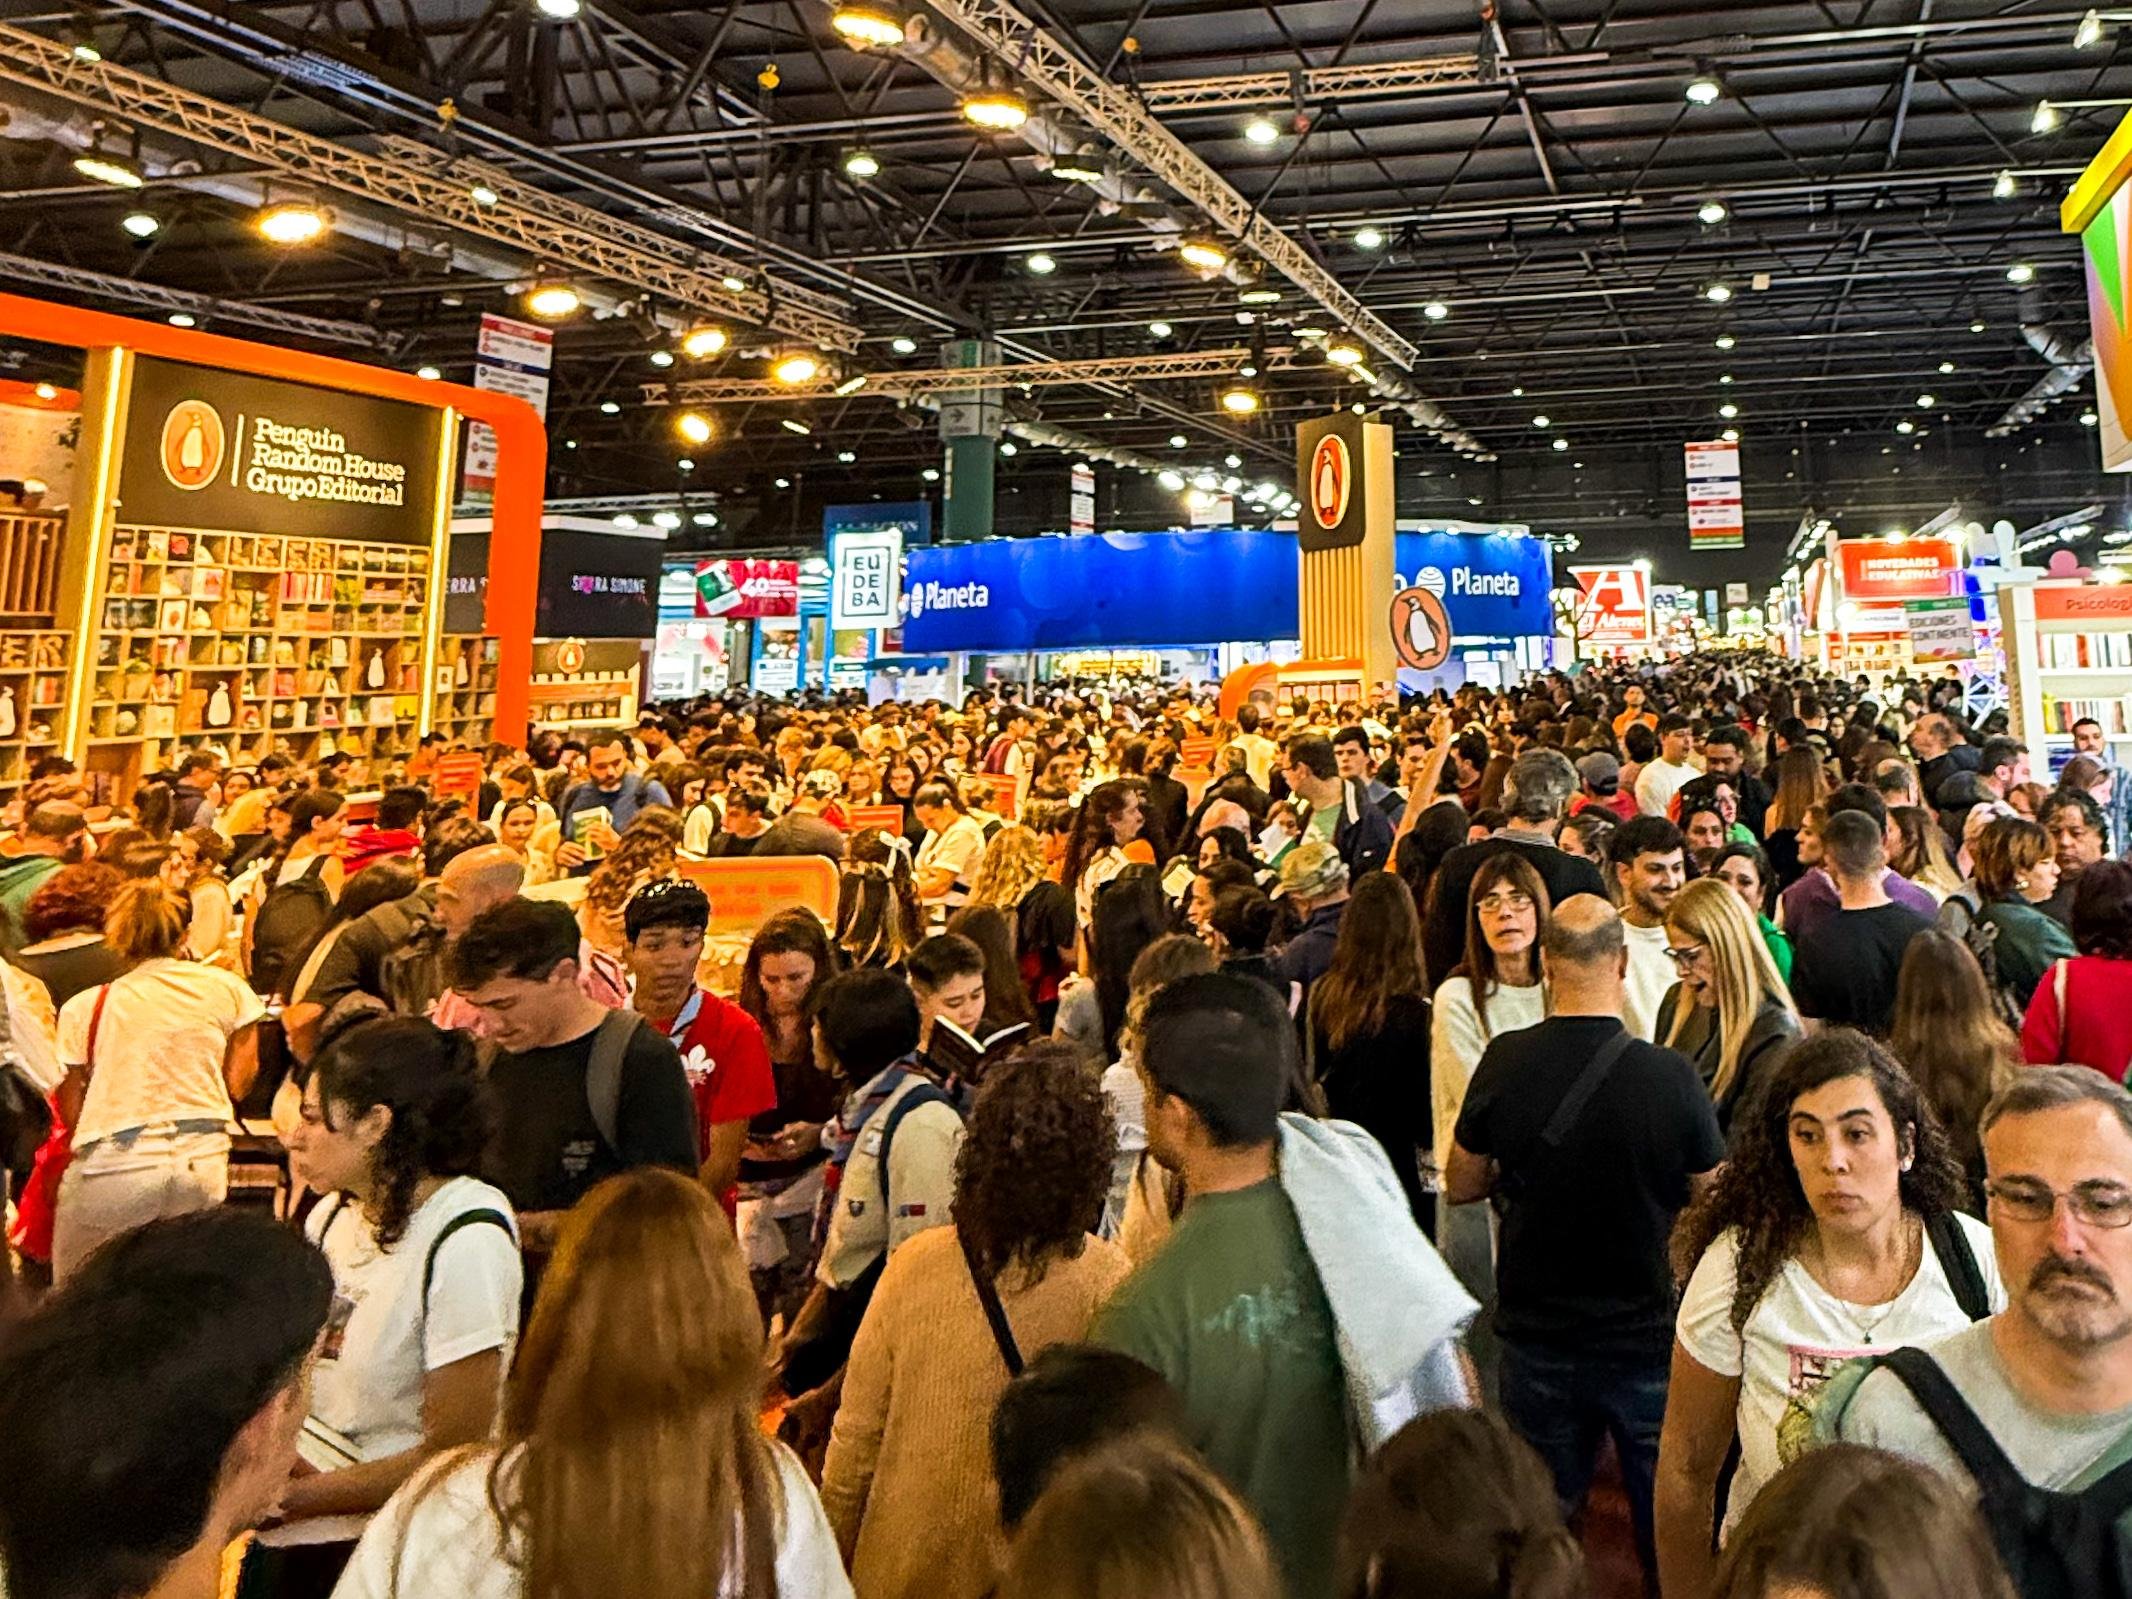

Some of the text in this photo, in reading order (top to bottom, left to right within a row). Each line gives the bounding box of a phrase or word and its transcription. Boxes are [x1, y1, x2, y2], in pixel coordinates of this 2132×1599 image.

[253, 417, 345, 456] Penguin
[251, 442, 405, 482] Random House
[246, 466, 404, 506] Grupo Editorial
[853, 555, 880, 571] EU
[853, 573, 880, 589] DE
[925, 581, 989, 609] Planeta
[1451, 566, 1520, 596] Planeta
[851, 591, 880, 607] BA
